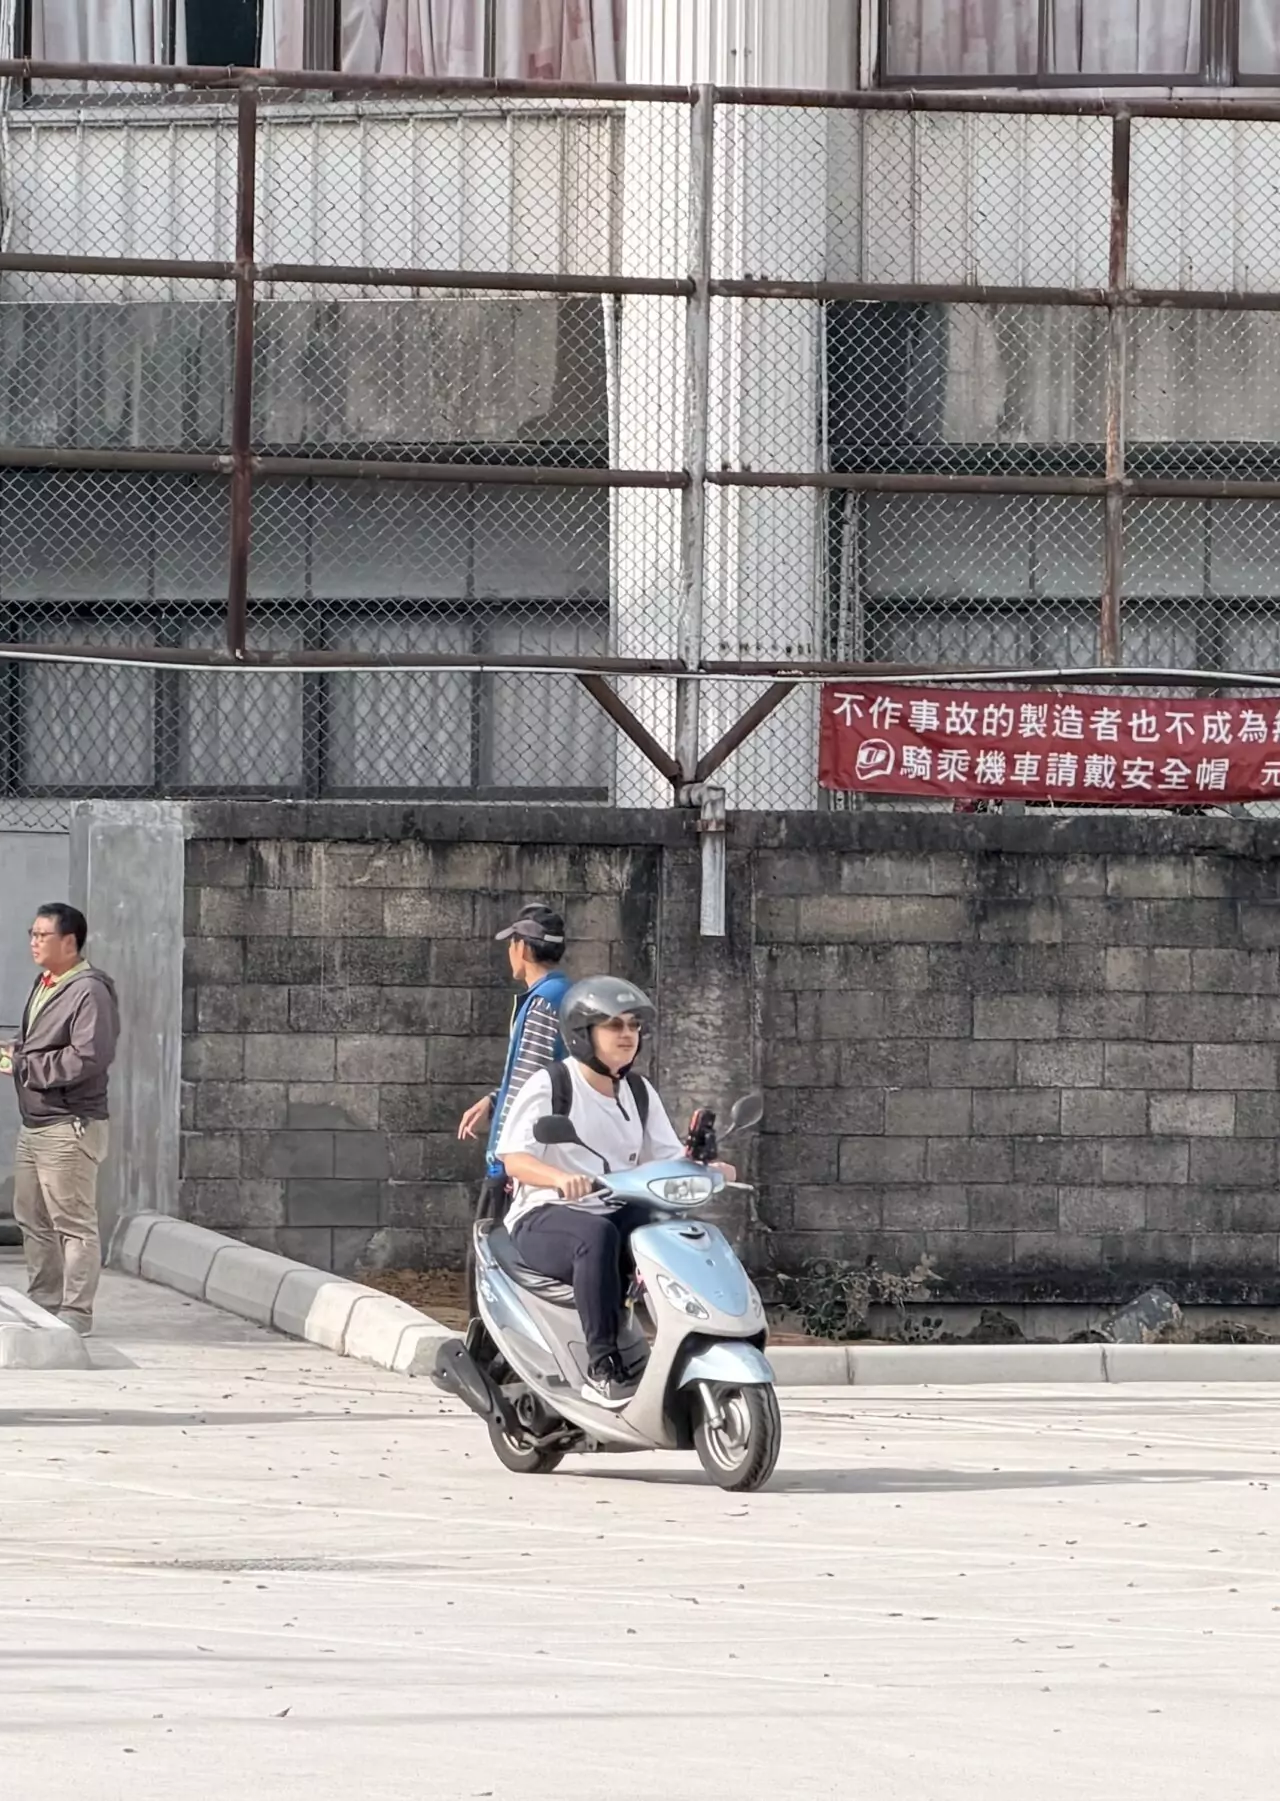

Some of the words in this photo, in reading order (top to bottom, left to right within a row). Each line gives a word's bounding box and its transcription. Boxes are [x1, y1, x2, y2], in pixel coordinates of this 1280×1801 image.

[900, 745, 1229, 790] 騎乘機車請戴安全帽
